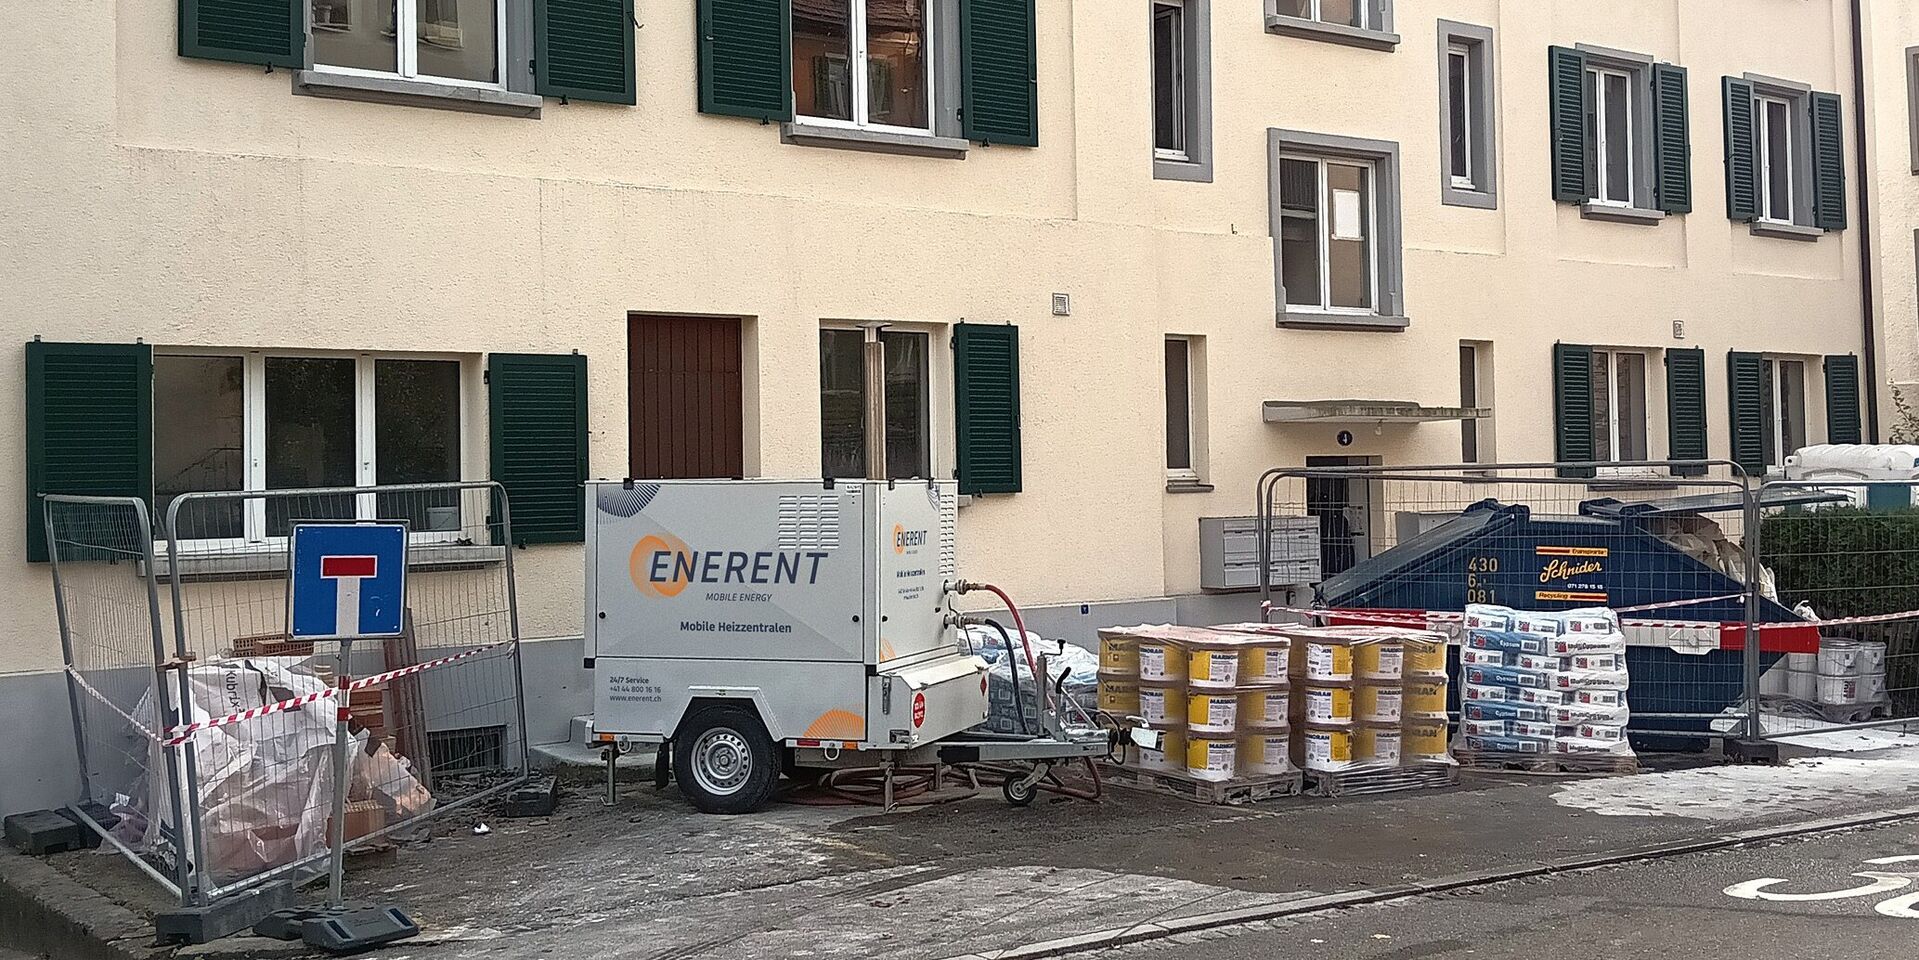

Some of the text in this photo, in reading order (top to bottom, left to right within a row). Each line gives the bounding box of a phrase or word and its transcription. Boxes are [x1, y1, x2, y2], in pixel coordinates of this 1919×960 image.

[896, 531, 927, 547] ENERENT
[649, 551, 829, 584] ENERENT
[1468, 557, 1498, 572] 430
[1539, 559, 1602, 583] Schnider
[705, 593, 772, 602] MOBILE ENERGY
[1467, 589, 1495, 603] 081
[1539, 592, 1568, 600] Recycling
[680, 621, 792, 633] Mobile Heizzentralen
[610, 676, 624, 684] 24/7
